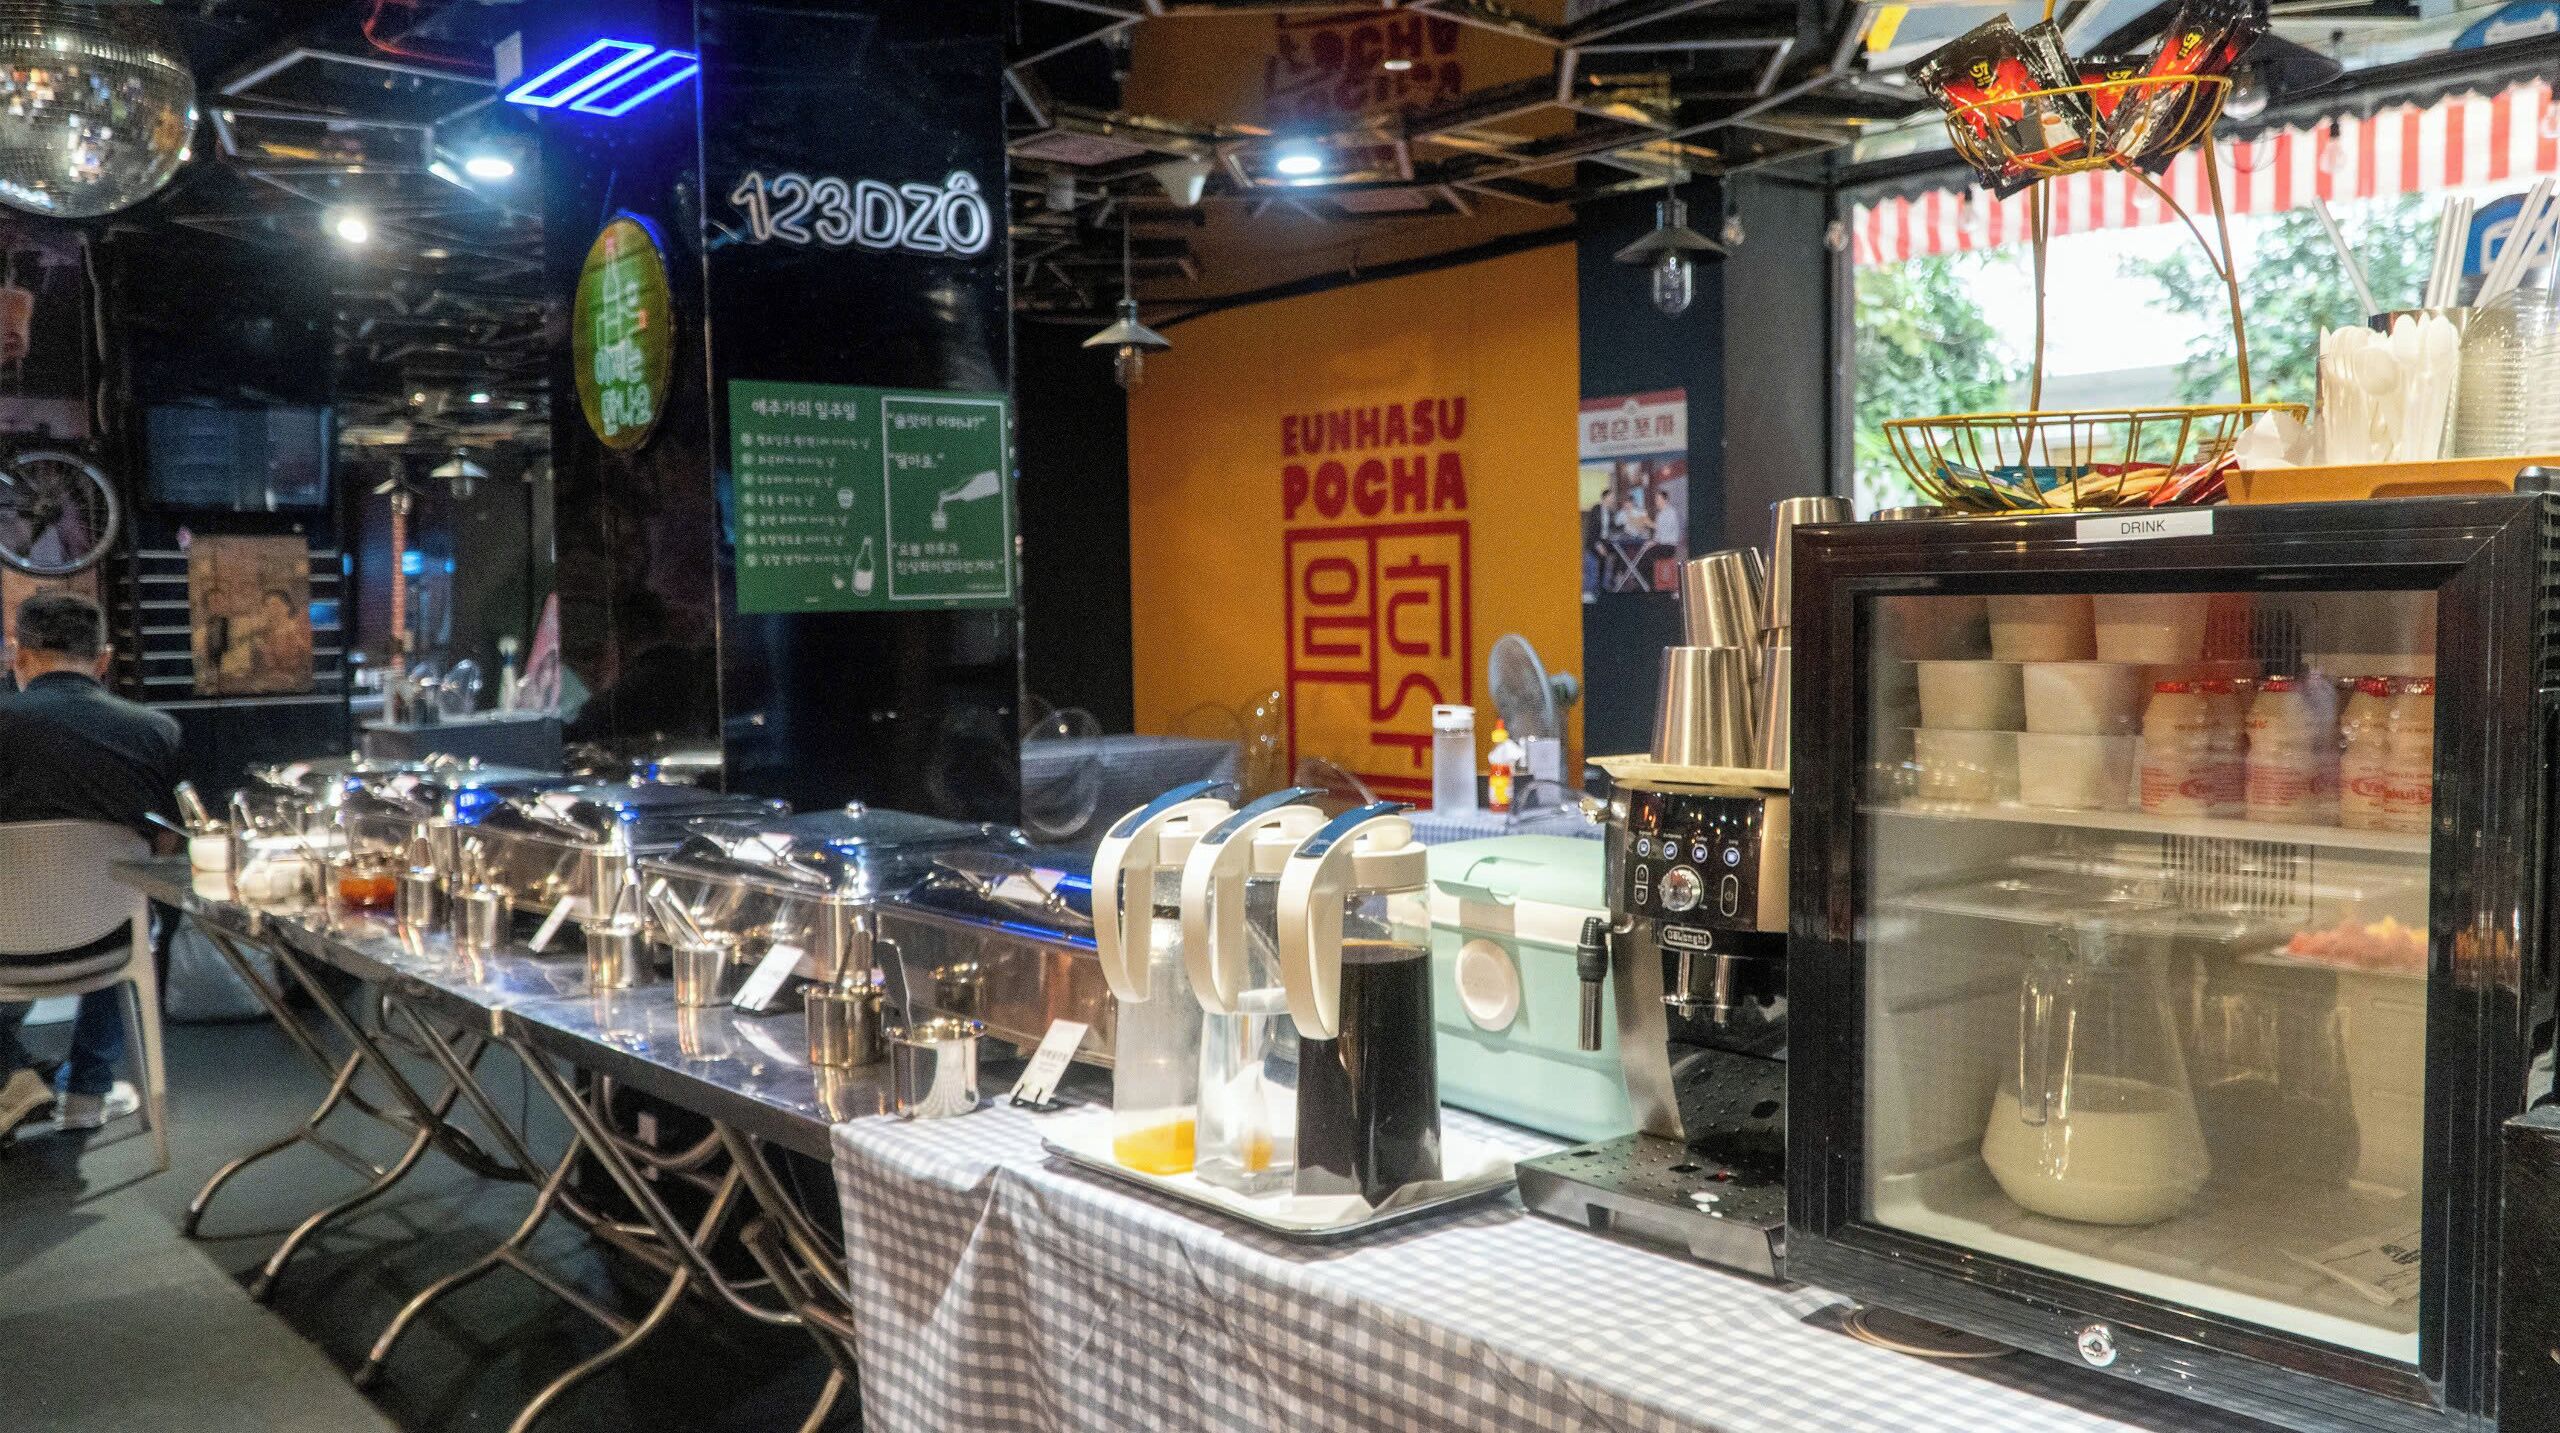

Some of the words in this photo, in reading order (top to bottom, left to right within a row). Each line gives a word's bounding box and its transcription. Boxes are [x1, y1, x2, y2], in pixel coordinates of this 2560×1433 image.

[752, 398, 812, 418] 애주가의
[815, 400, 857, 421] 일주일
[1281, 396, 1466, 457] EUNHASU
[1282, 451, 1469, 521] POCHA
[2121, 520, 2166, 534] DRINK
